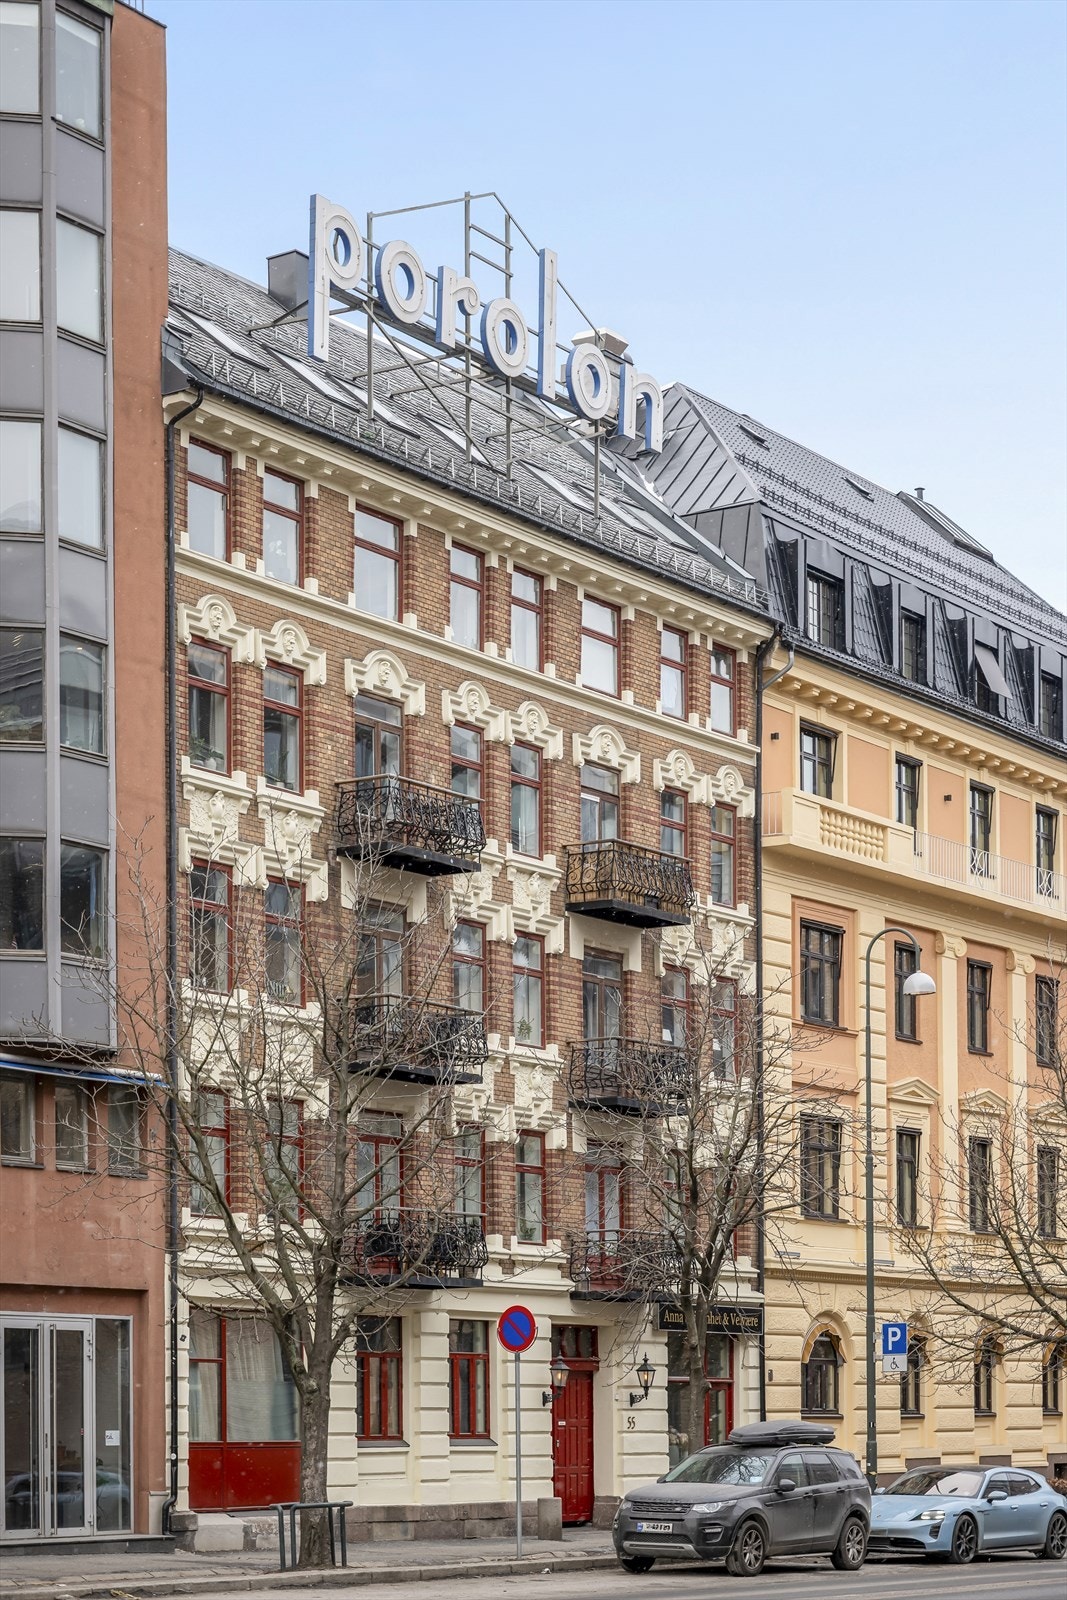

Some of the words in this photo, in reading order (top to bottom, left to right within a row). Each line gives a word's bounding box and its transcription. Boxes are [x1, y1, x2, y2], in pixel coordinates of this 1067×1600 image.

[308, 193, 664, 454] porolon
[664, 1310, 684, 1323] Anna
[722, 1312, 729, 1325] &
[888, 1327, 901, 1351] P
[627, 1416, 636, 1430] 55
